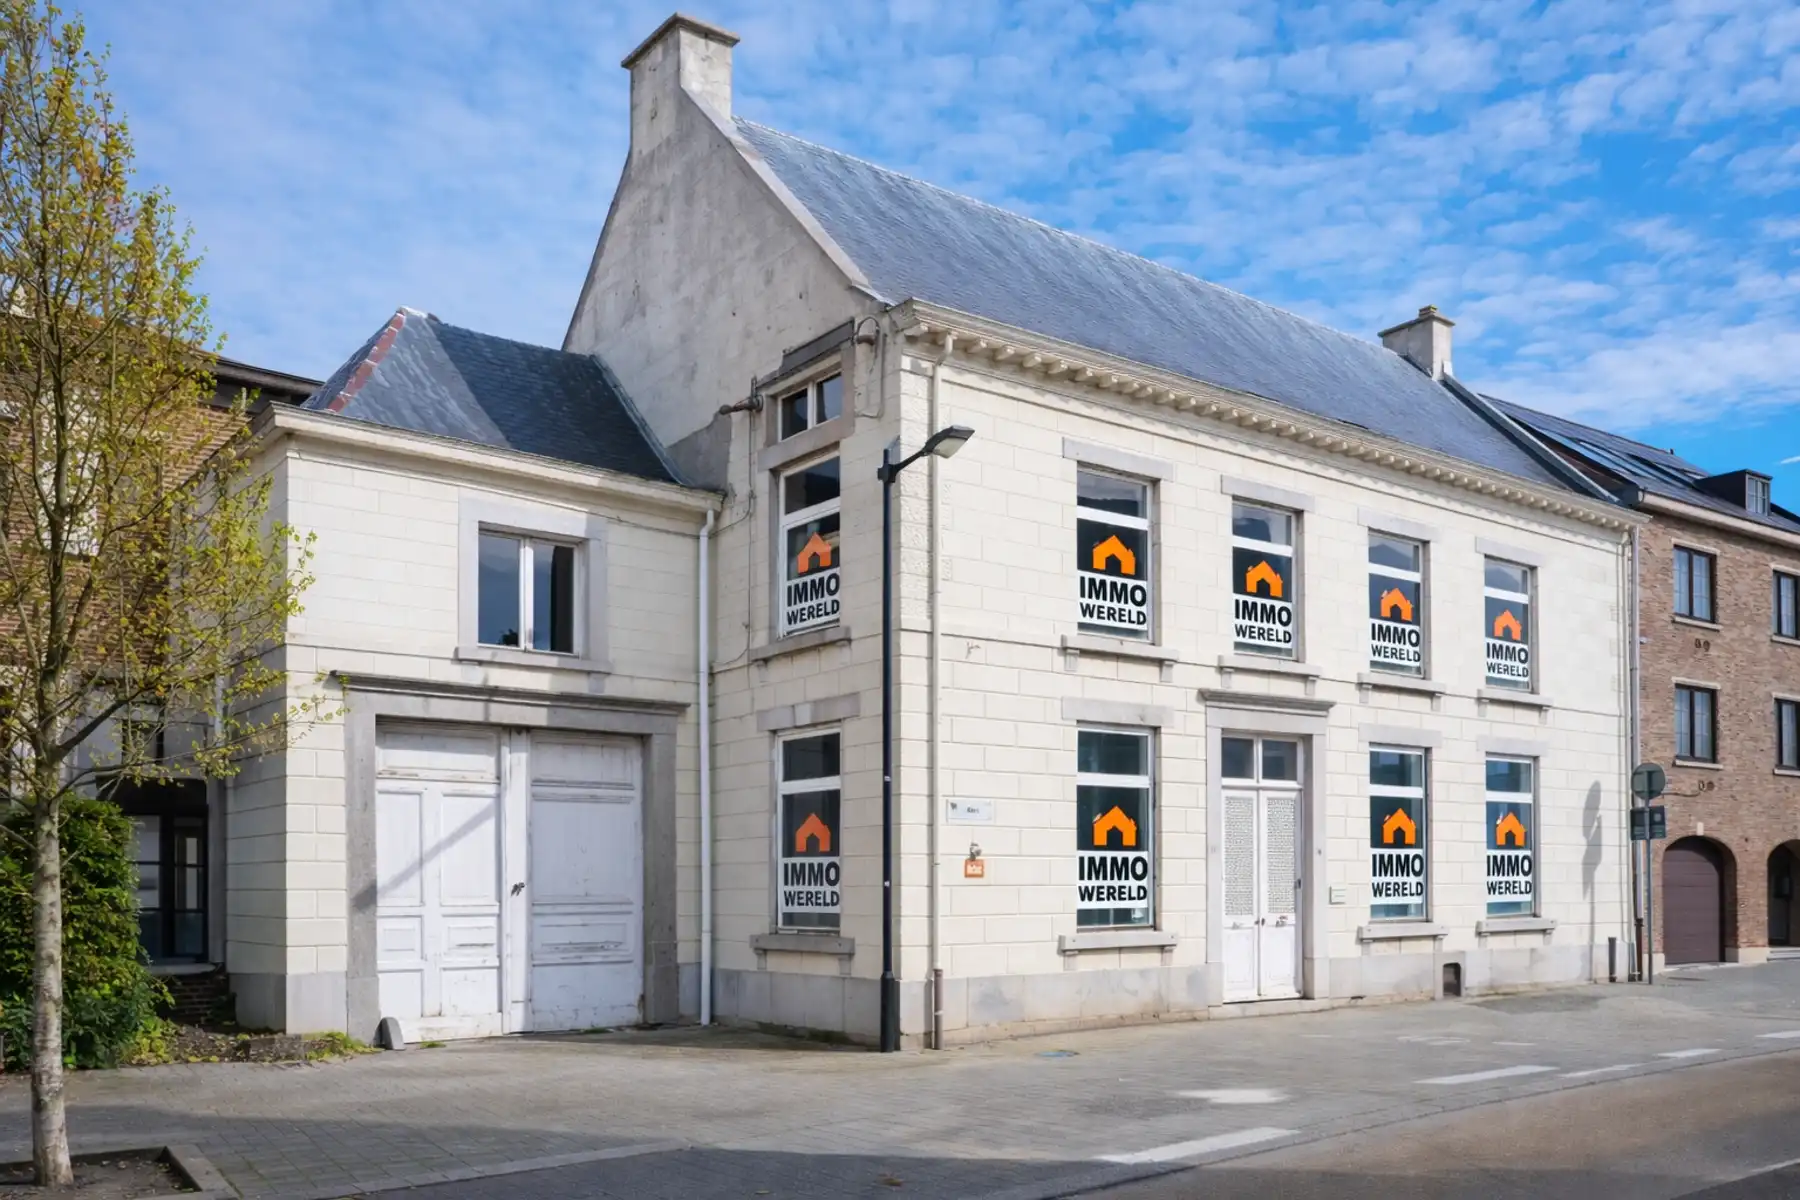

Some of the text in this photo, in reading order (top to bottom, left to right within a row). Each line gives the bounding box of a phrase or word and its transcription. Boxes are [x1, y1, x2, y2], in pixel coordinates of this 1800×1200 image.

[787, 572, 840, 607] IMMO
[1080, 576, 1147, 607] IMMO
[787, 599, 840, 625] WERELD
[1080, 602, 1147, 625] WERELD
[1235, 599, 1292, 627] IMMO
[1235, 624, 1292, 644] WERELD
[1371, 623, 1420, 647] IMMO
[1371, 644, 1421, 662] WERELD
[1486, 642, 1529, 664] IMMO
[1486, 661, 1529, 677] WERELD
[783, 861, 840, 887] IMMO
[1079, 856, 1148, 881] IMMO
[1371, 853, 1424, 877] IMMO
[1486, 855, 1532, 877] IMMO
[783, 890, 840, 907] WERELD
[1078, 885, 1147, 902] WERELD
[1371, 881, 1424, 897] WERELD
[1486, 880, 1532, 895] WERELD
